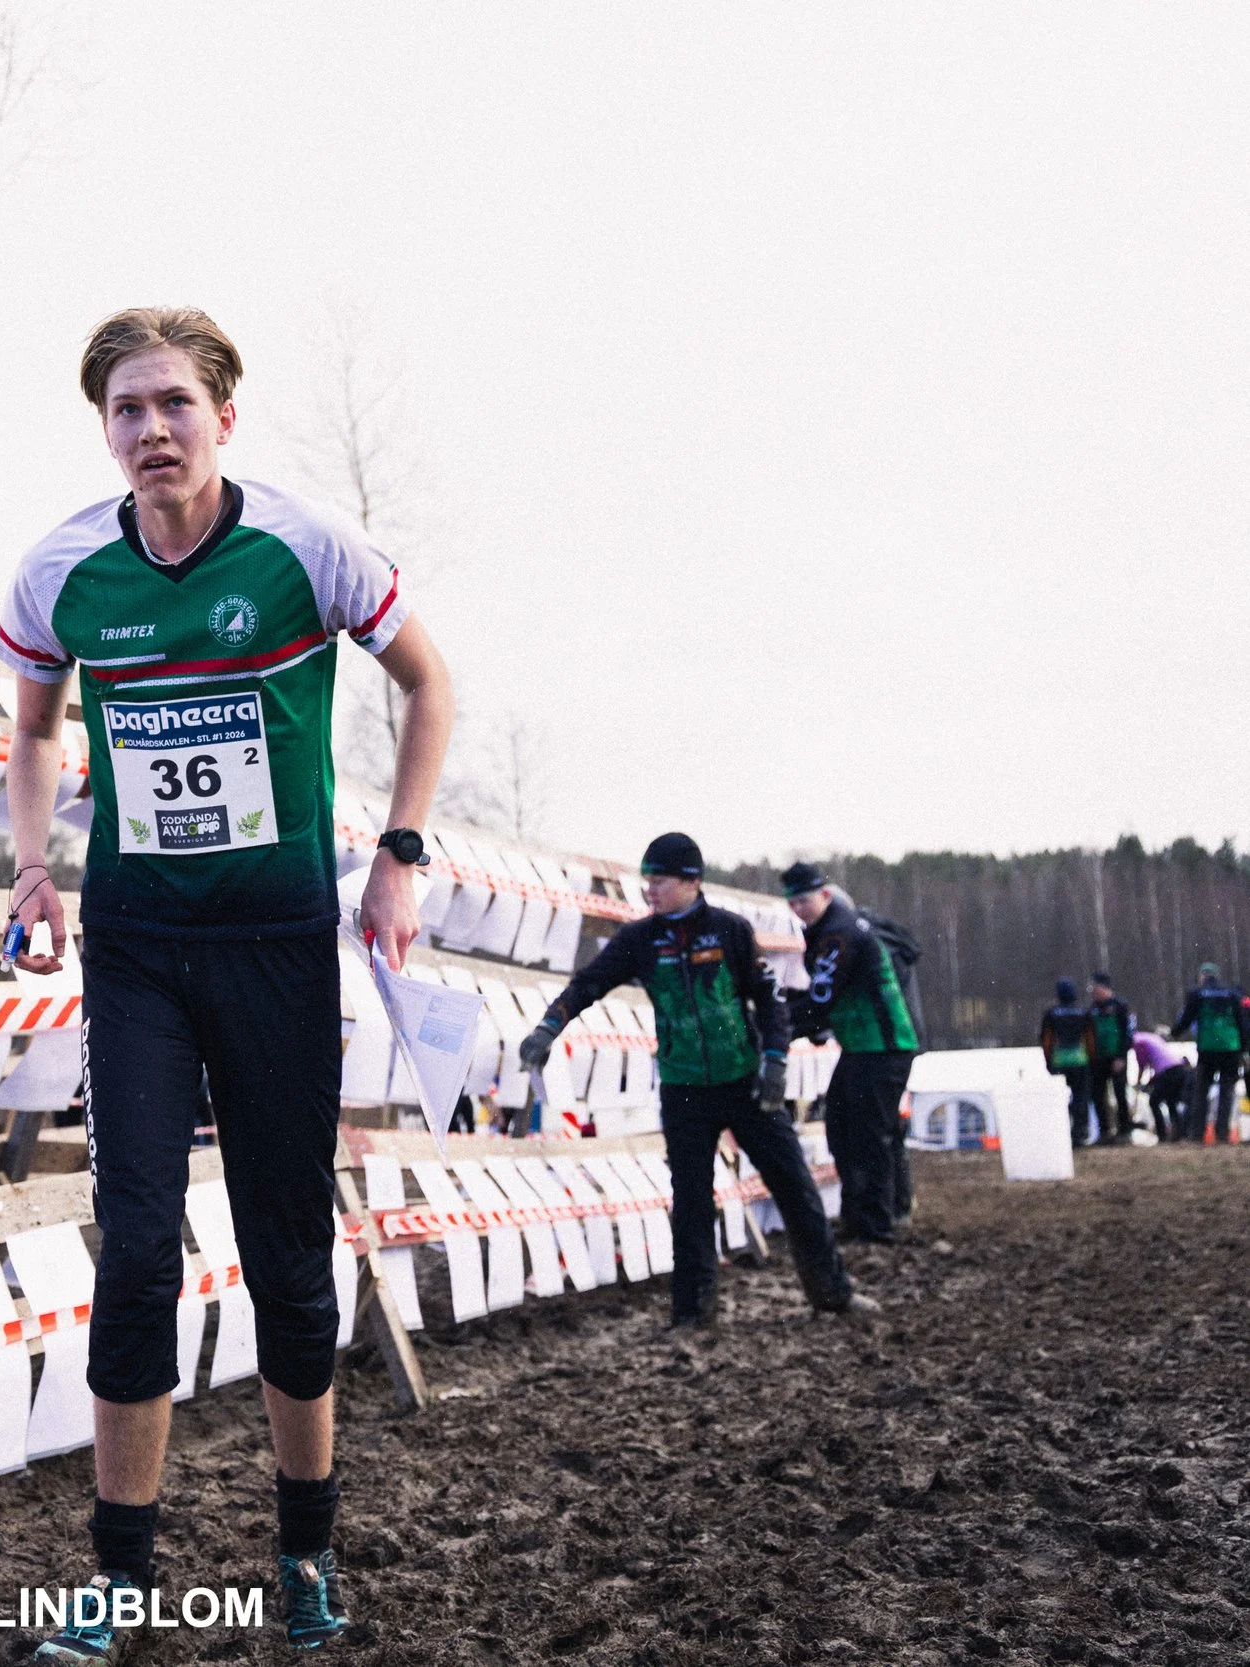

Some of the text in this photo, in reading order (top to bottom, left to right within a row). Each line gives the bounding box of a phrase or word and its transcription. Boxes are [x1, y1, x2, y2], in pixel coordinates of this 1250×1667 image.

[100, 624, 156, 641] TRIMTEX
[107, 701, 257, 735] bagheera
[124, 736, 190, 748] KOLMÅRDSKAVLEN
[196, 733, 211, 743] STL
[212, 732, 223, 741] #1
[224, 730, 246, 740] 2026
[243, 747, 259, 765] 2
[150, 755, 222, 801] 36
[161, 812, 220, 825] GODKÄNDA
[162, 820, 220, 837] AVLOPP
